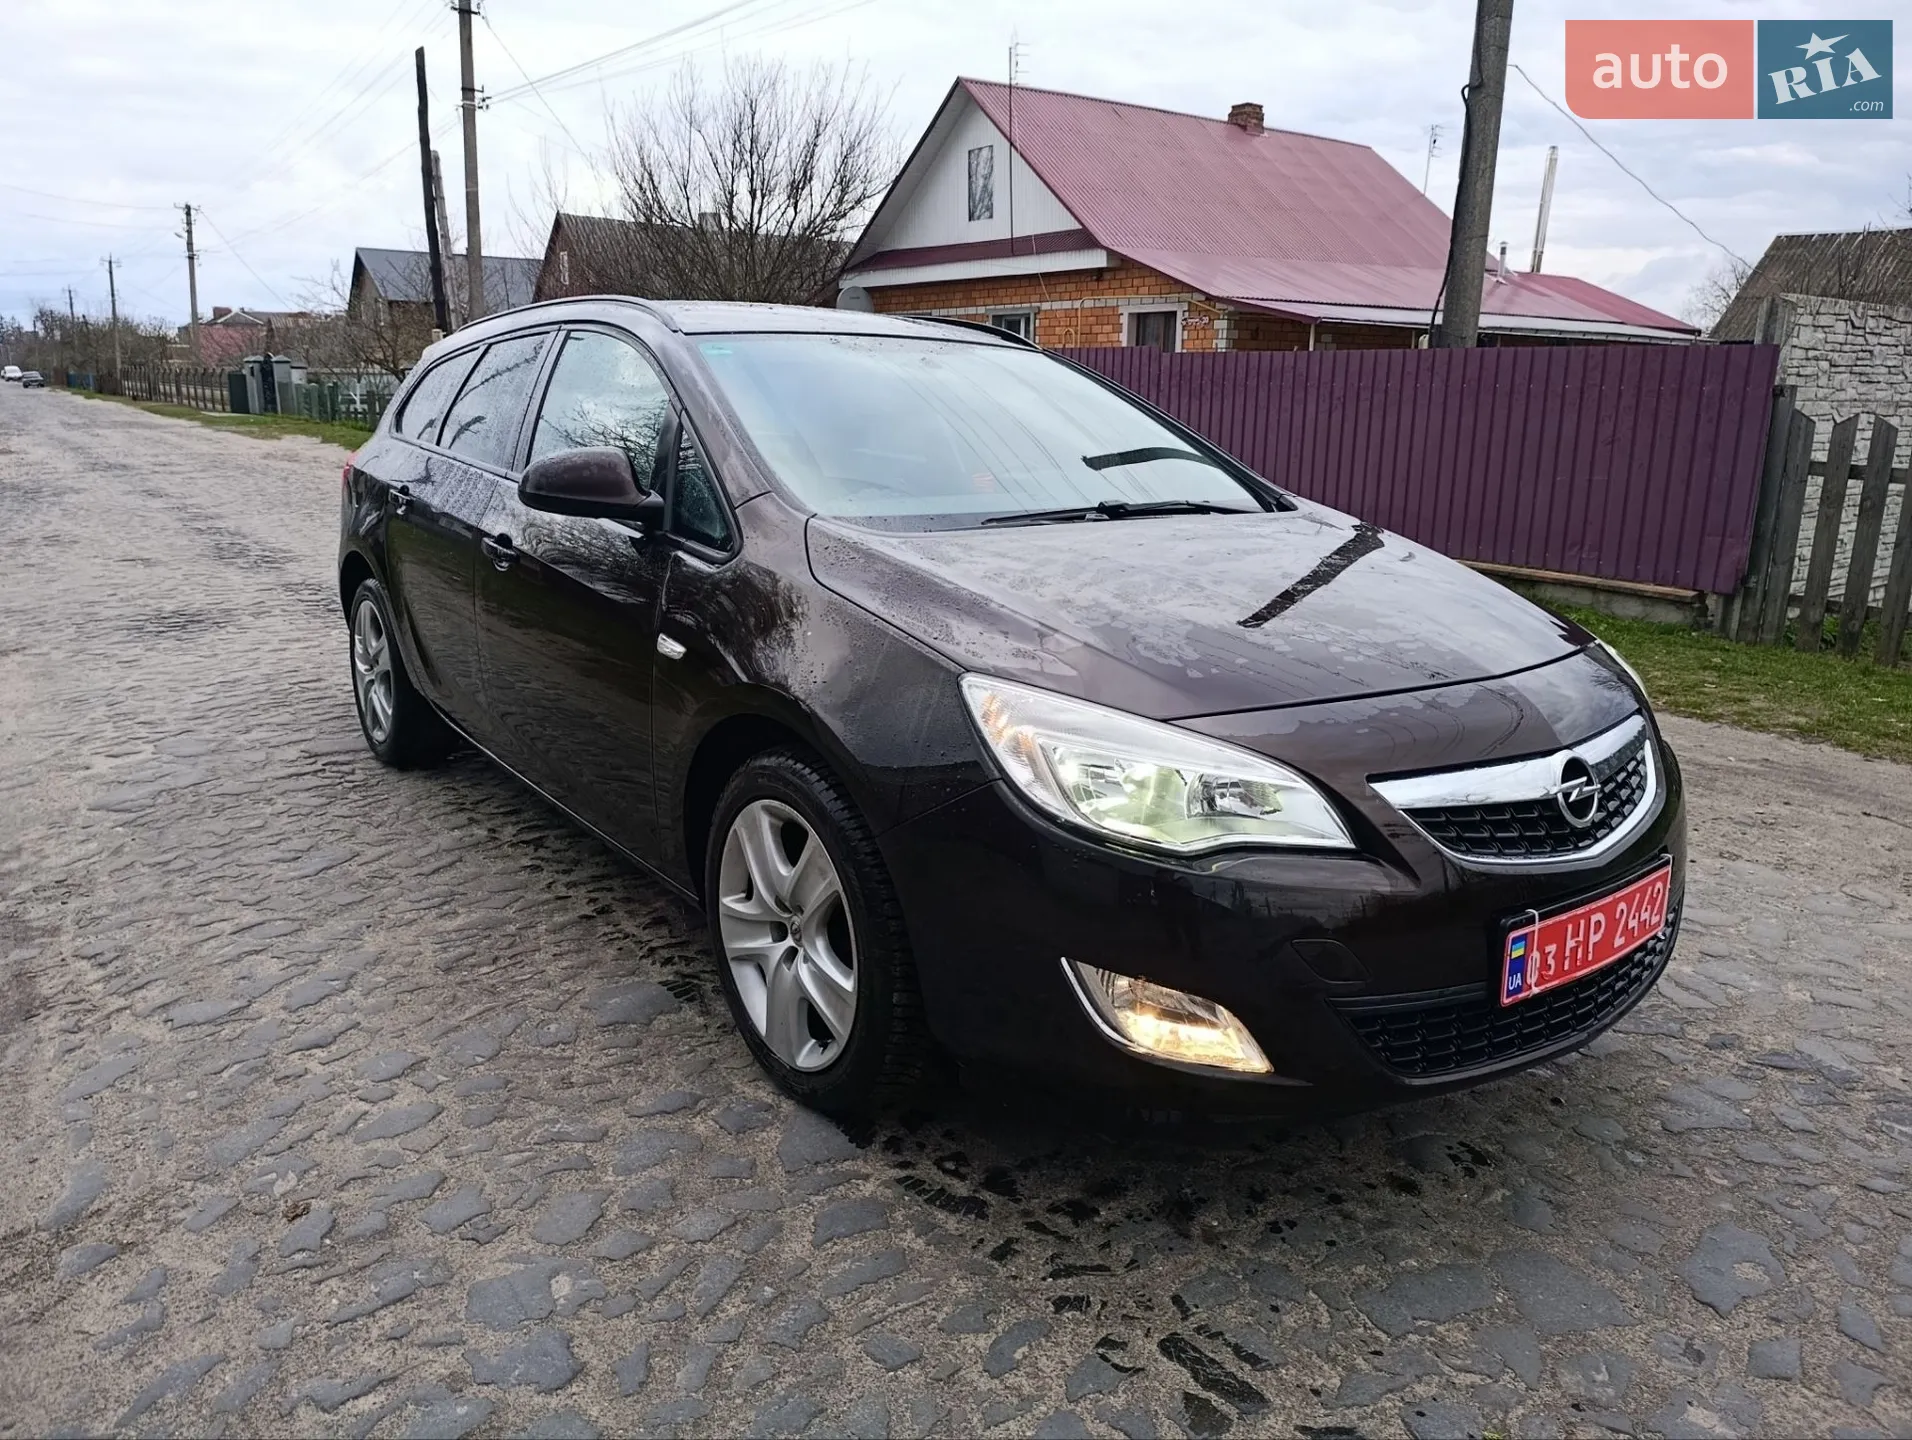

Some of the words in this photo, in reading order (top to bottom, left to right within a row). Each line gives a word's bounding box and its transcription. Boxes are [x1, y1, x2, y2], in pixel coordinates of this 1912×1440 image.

[1564, 912, 1605, 971] HP
[1613, 881, 1663, 949] 2442
[1508, 974, 1522, 990] UA
